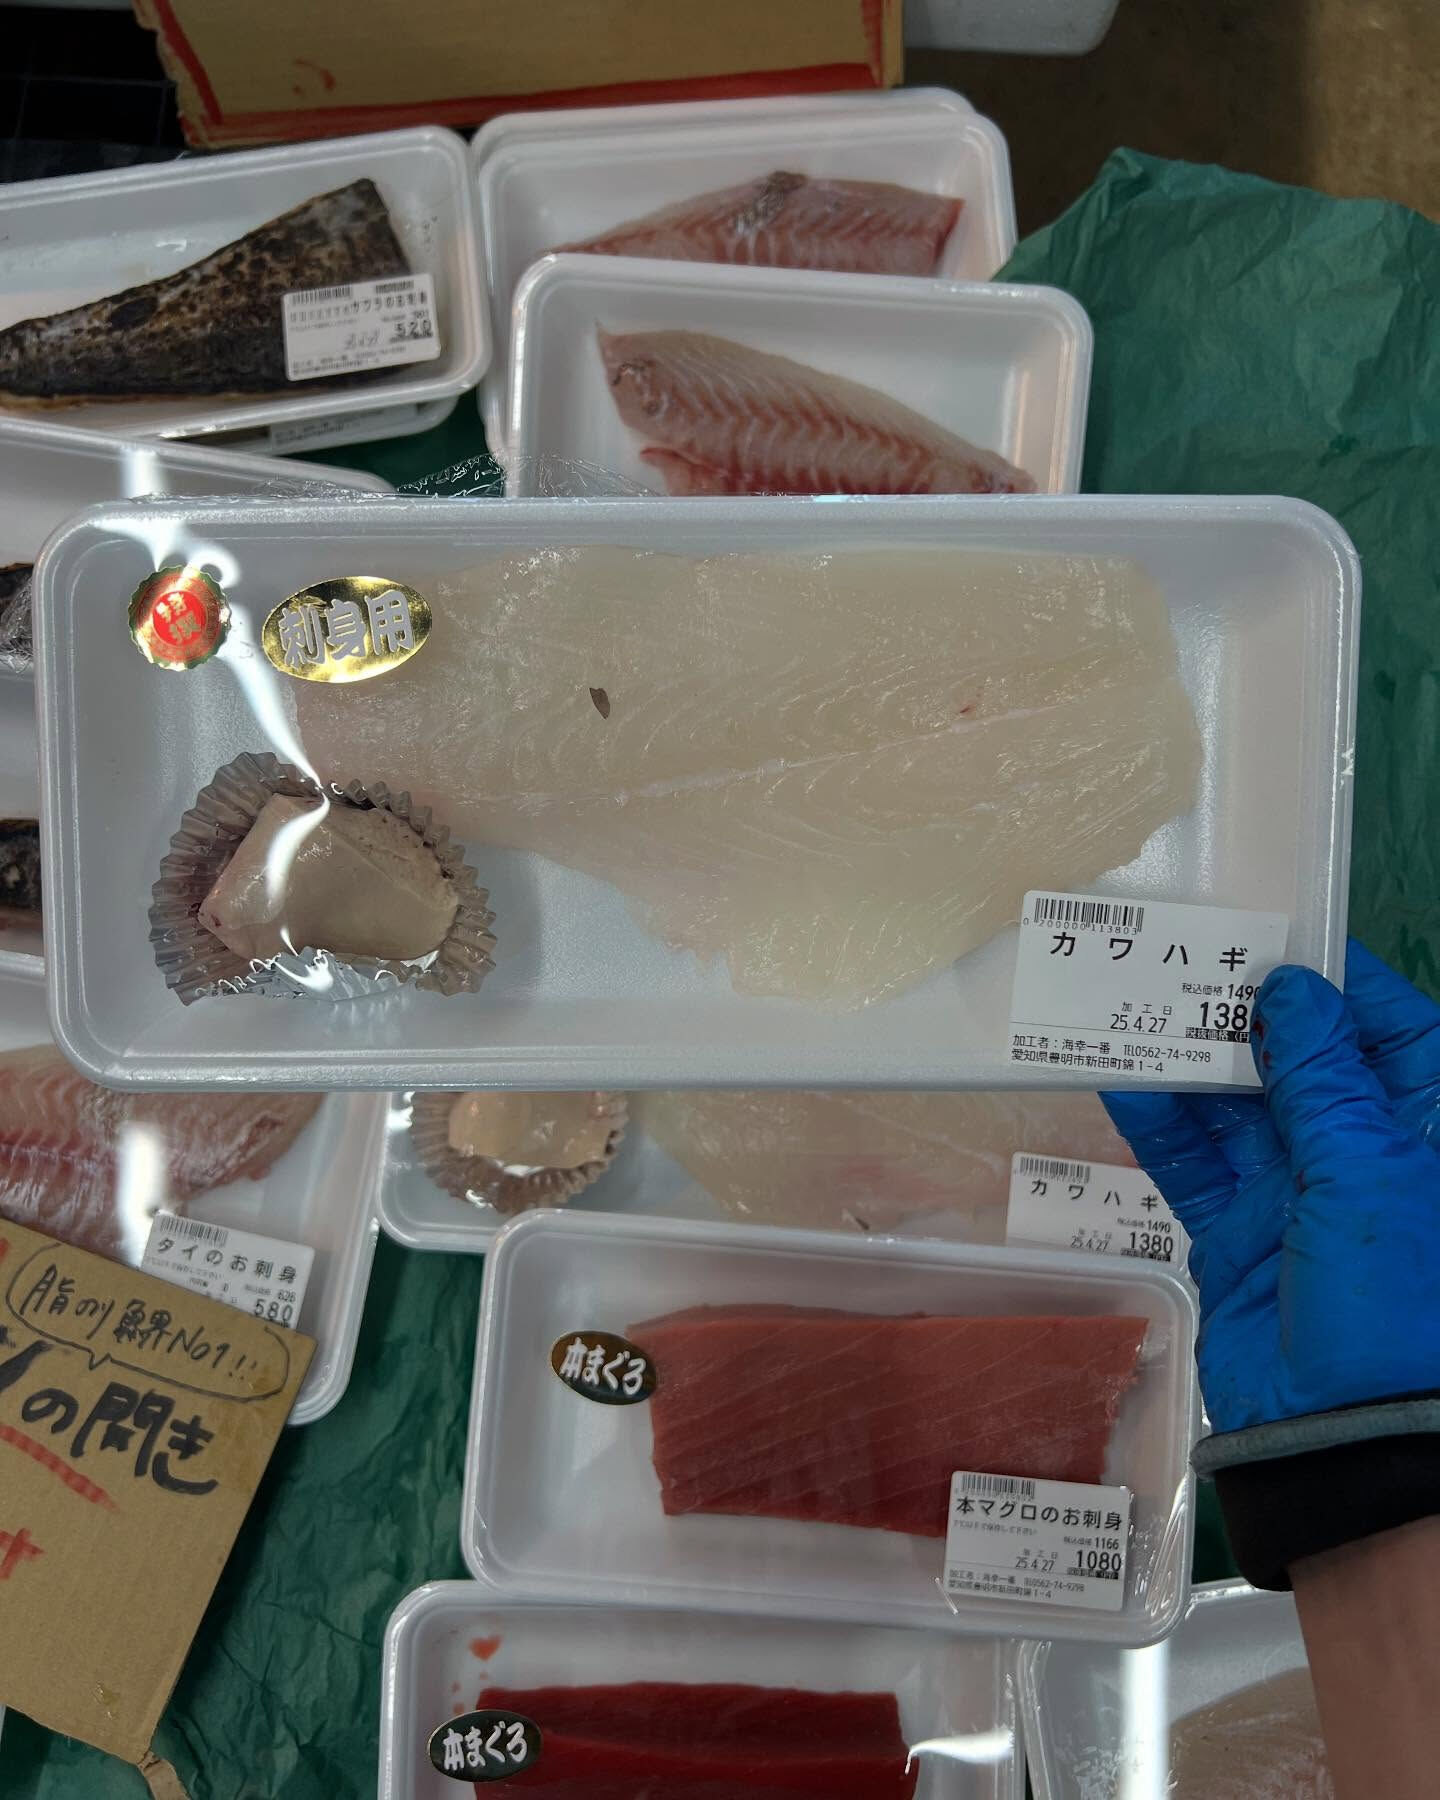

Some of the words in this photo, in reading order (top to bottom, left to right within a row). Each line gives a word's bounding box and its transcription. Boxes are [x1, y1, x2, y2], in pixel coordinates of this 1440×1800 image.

[277, 589, 415, 668] 刺身用
[1050, 931, 1248, 972] カワハギ
[1182, 982, 1223, 997] 税込価格
[1122, 1001, 1172, 1016] 加工日
[1200, 1001, 1248, 1031] 138
[1110, 1013, 1167, 1034] 25.4.27
[1031, 1178, 1159, 1212] カワハギ
[1147, 1219, 1171, 1233] 1490
[1130, 1231, 1173, 1254] 1380
[157, 1237, 297, 1283] タイのお刺身
[254, 1298, 293, 1322] 580
[560, 1337, 646, 1396] 本まぐろ
[956, 1496, 1122, 1531] 本マグロのお刺身
[1095, 1536, 1119, 1550] 1166
[1076, 1550, 1122, 1572] 1080
[443, 1720, 528, 1771] 本まぐろ
